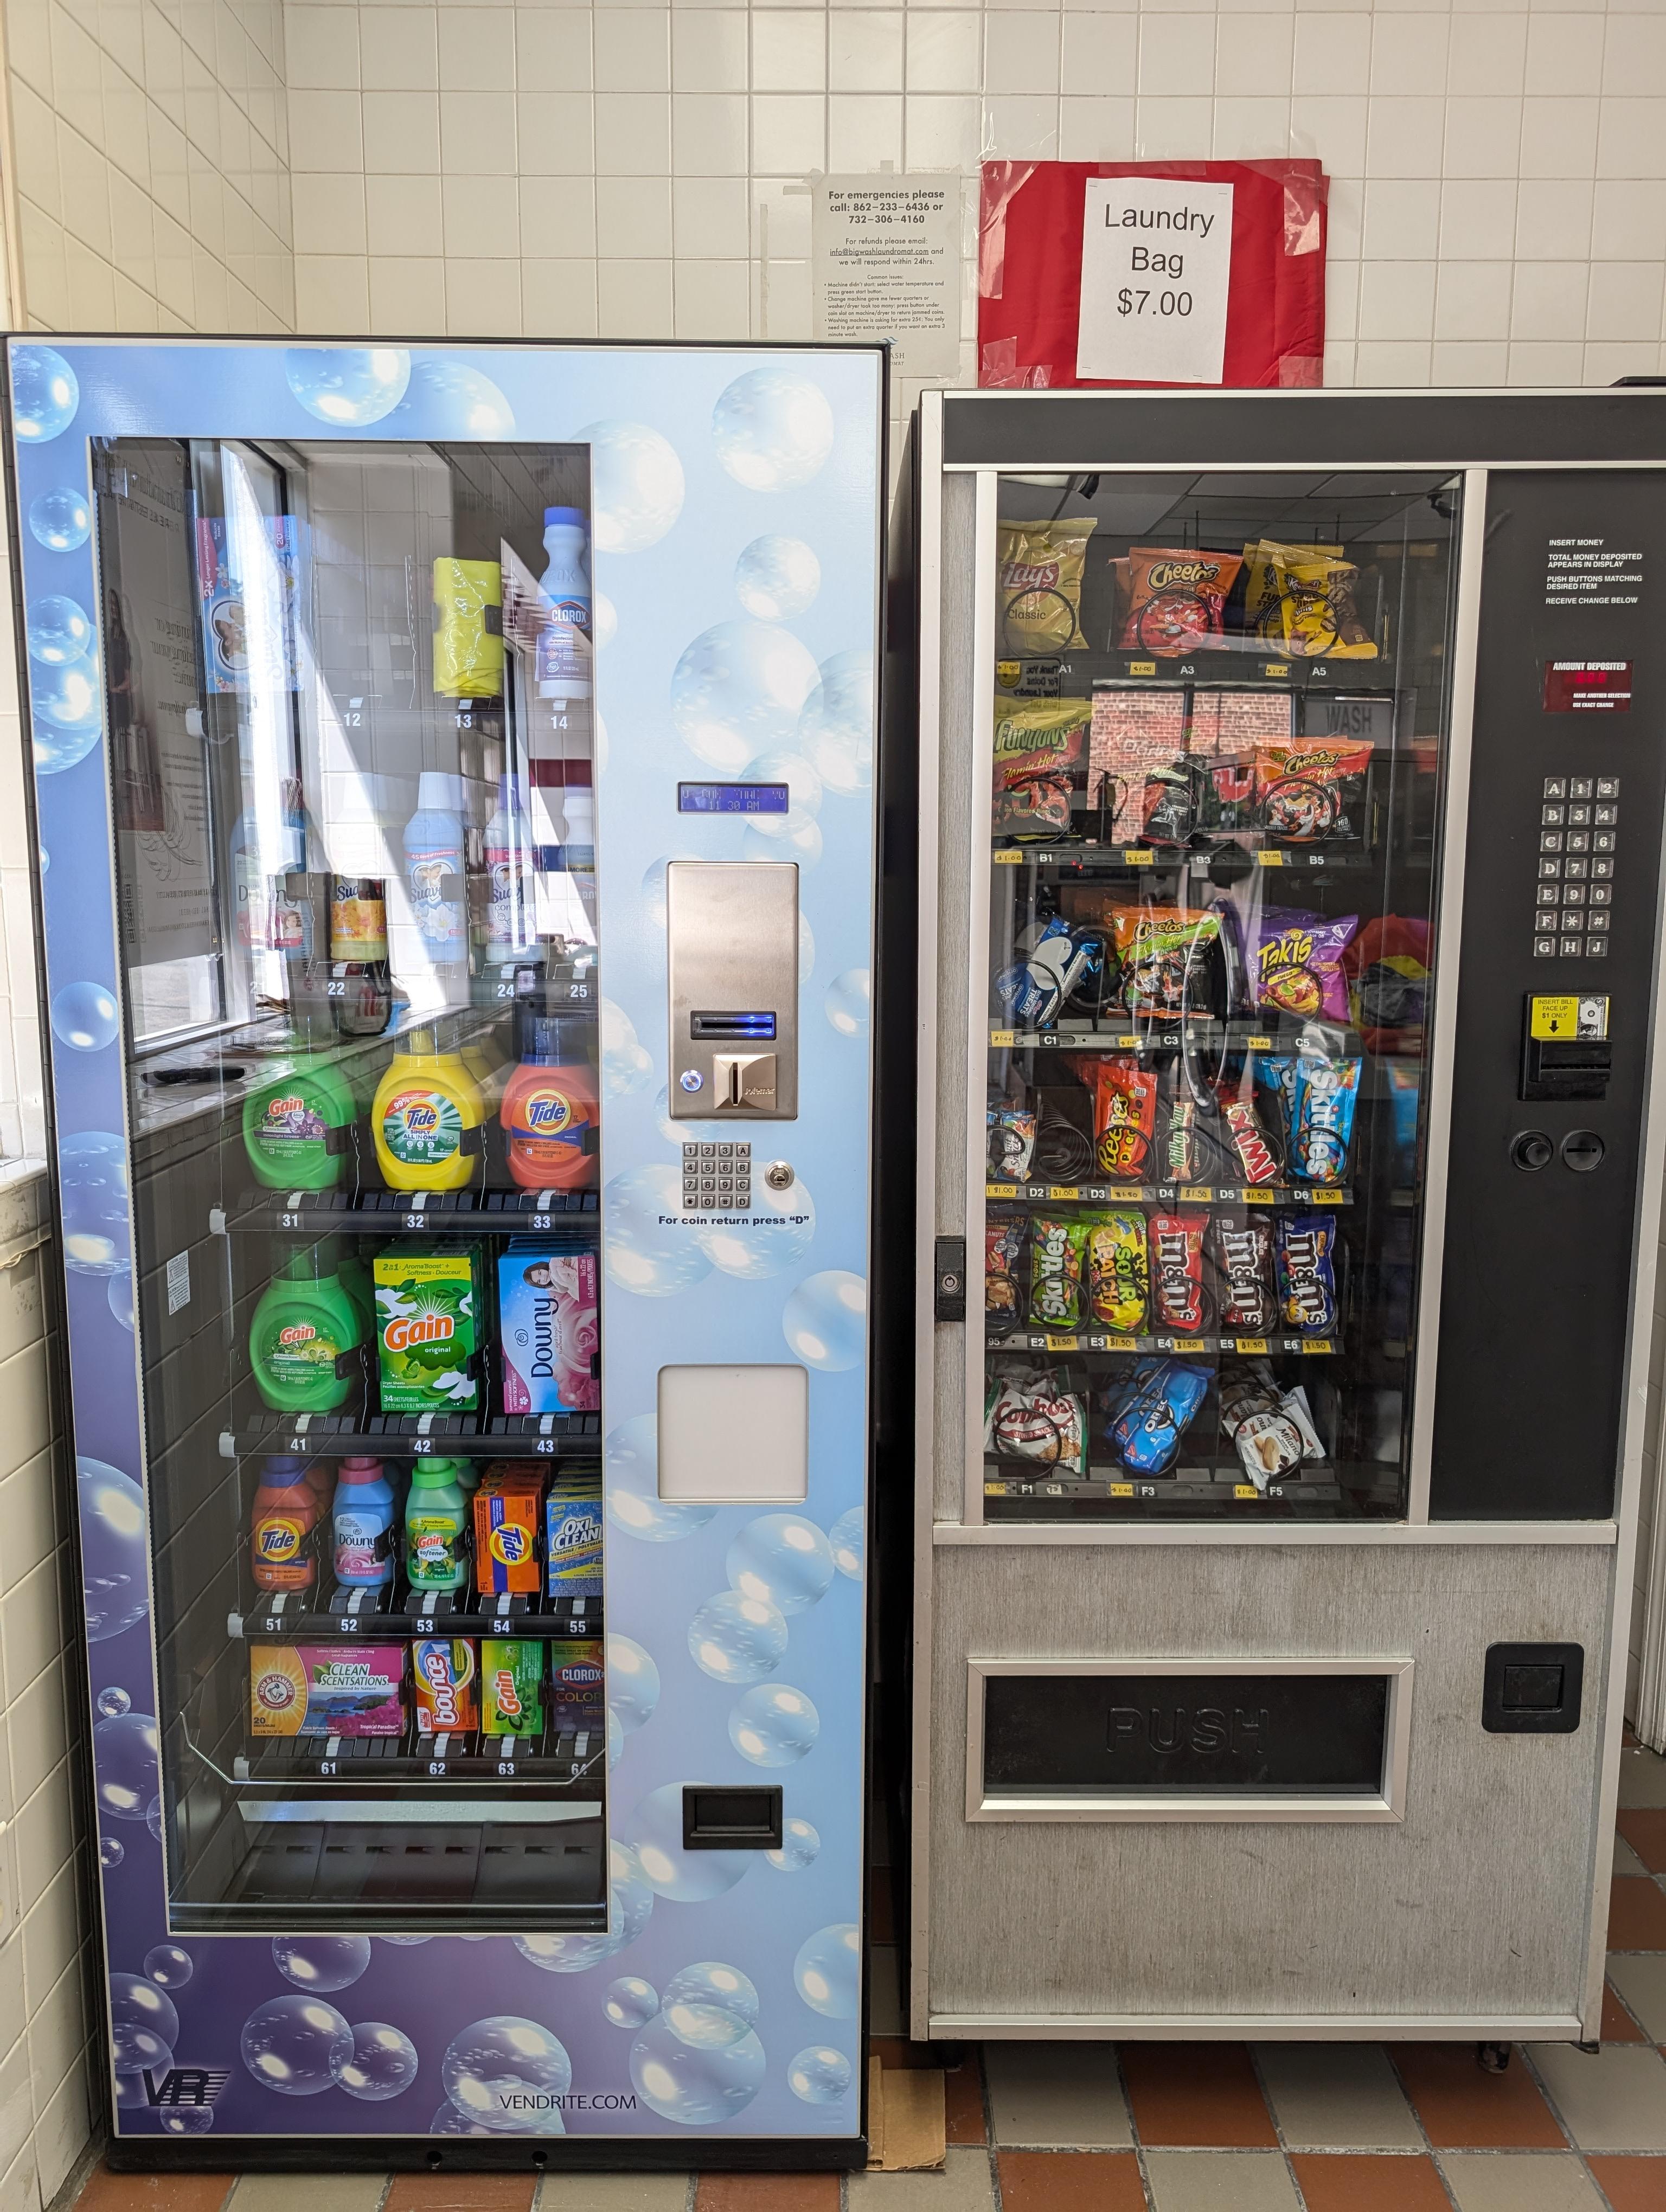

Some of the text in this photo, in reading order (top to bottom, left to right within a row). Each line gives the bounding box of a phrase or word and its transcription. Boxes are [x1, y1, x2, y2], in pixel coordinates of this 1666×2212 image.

[829, 190, 945, 201] For emergencies please
[830, 203, 850, 212] call:
[1105, 204, 1214, 238] Laundry
[885, 237, 907, 246] please
[830, 248, 928, 256] info@bigwashlaundromat.com
[864, 258, 890, 267] respond
[1131, 247, 1183, 279] Bag
[1117, 288, 1192, 317] $7.00
[1004, 564, 1056, 589] Lay's
[552, 609, 586, 622] CLOROX
[1008, 610, 1046, 619] Classic
[1059, 665, 1071, 673] A1
[1181, 666, 1194, 674] A3
[1312, 667, 1327, 676] A5
[344, 713, 361, 726] 12
[455, 715, 472, 728] 13
[551, 716, 567, 729] 14
[1283, 750, 1340, 776] Cheetos
[1040, 854, 1052, 862] B1
[1134, 919, 1186, 942] Cheetos
[328, 983, 345, 995] 22
[498, 985, 515, 997] 24
[571, 985, 587, 997] 25
[1044, 1036, 1056, 1045] C1
[1164, 1036, 1178, 1045] C3
[1295, 1038, 1309, 1047] C5
[270, 1098, 304, 1116] Gain
[394, 1097, 409, 1109] 99%
[407, 1108, 437, 1129] Tide
[529, 1101, 566, 1127] Tide
[1306, 1070, 1337, 1175] Skittles
[1091, 1189, 1105, 1198] D3
[1159, 1189, 1174, 1198] D4
[1220, 1191, 1234, 1199] D5
[1294, 1191, 1308, 1199] D6
[283, 1214, 298, 1226] 31
[407, 1215, 424, 1228] 32
[534, 1216, 550, 1229] 33
[753, 1218, 785, 1226] press
[1042, 1227, 1067, 1317] Skittles
[280, 1326, 316, 1343] Gain
[385, 1315, 454, 1352] Gain
[531, 1298, 559, 1378] Downy
[1158, 1340, 1171, 1348] E4
[1221, 1340, 1233, 1348] E5
[1284, 1341, 1297, 1349] E6
[291, 1439, 306, 1451] 41
[414, 1441, 431, 1452] 42
[537, 1440, 554, 1452] 43
[1276, 1428, 1300, 1456] Milano
[1022, 1484, 1033, 1493] F1
[1142, 1487, 1154, 1495] F3
[1270, 1487, 1282, 1495] F5
[563, 1519, 591, 1533] OXI
[262, 1531, 296, 1553] Tide
[418, 1535, 444, 1548] Gain
[496, 1527, 523, 1561] Tide
[555, 1527, 600, 1549] CLEAN
[266, 1619, 280, 1630] 51
[341, 1619, 357, 1631] 52
[417, 1620, 433, 1632] 53
[494, 1621, 510, 1632] 54
[570, 1621, 586, 1633] 55
[331, 1663, 369, 1675] CLEAN
[433, 1653, 459, 1727] bounce
[496, 1670, 522, 1715] Gain
[1106, 1708, 1268, 1753] PUSH
[321, 1763, 336, 1774] 61
[430, 1763, 445, 1774] 62
[498, 1763, 514, 1774] 63
[499, 2095, 637, 2109] VENDRITE.COM
